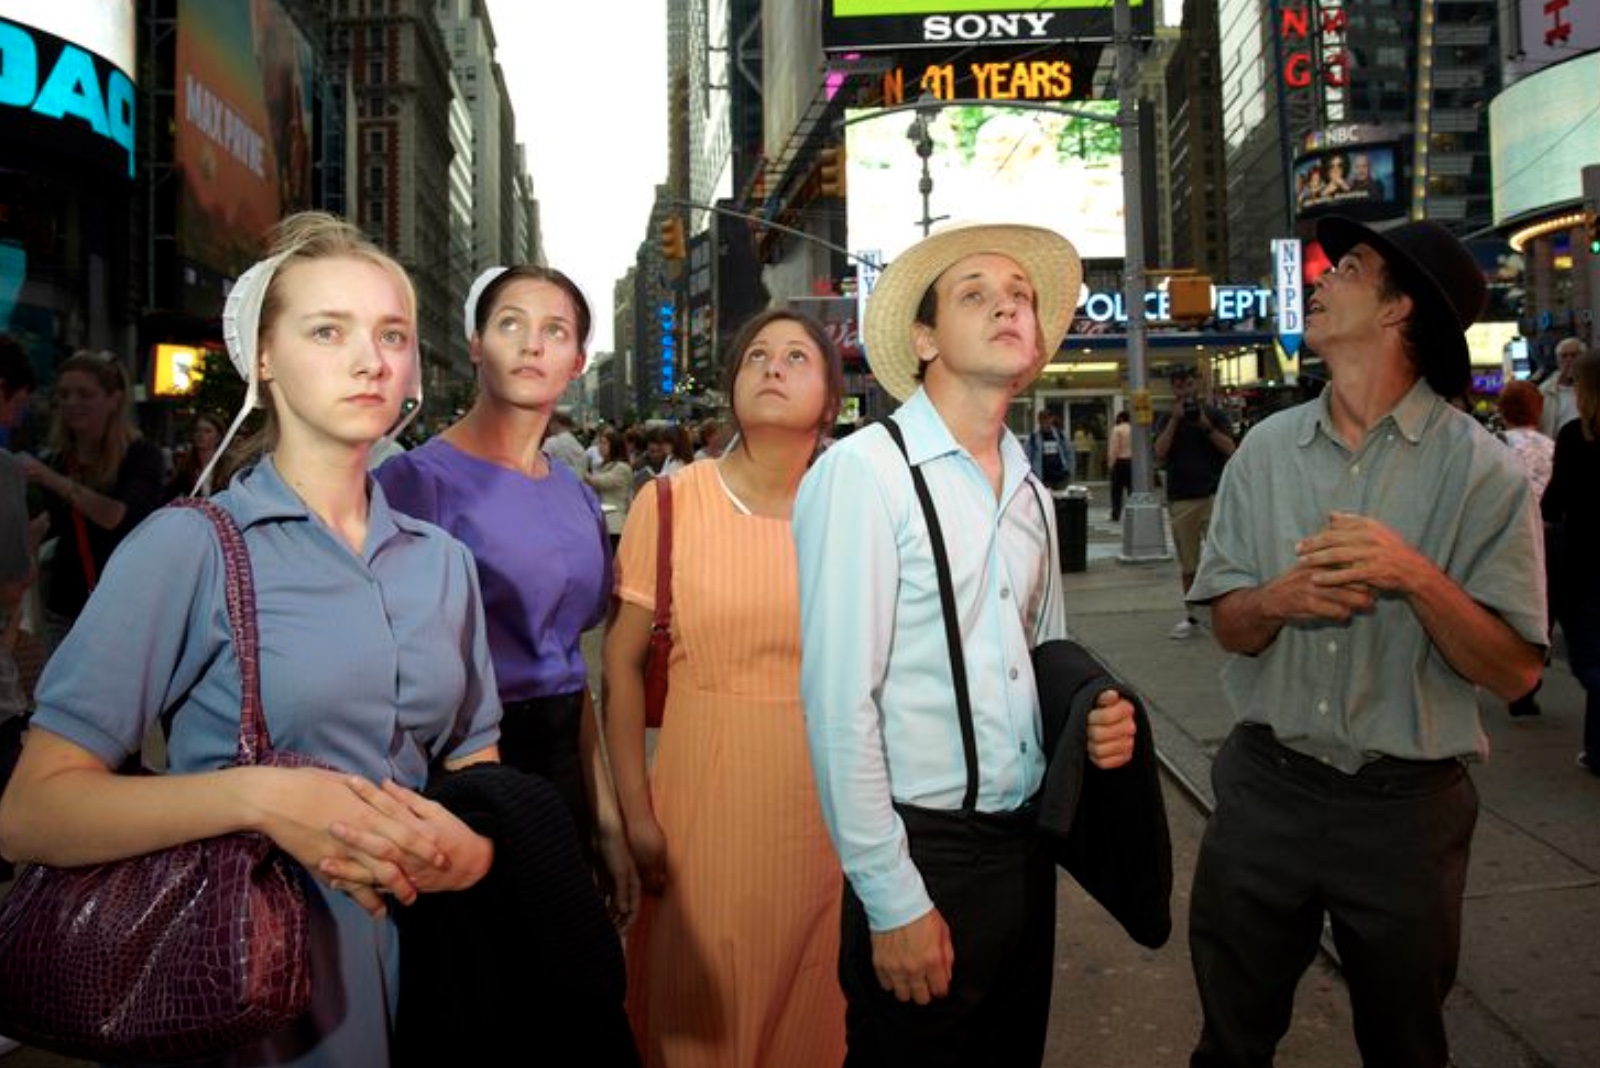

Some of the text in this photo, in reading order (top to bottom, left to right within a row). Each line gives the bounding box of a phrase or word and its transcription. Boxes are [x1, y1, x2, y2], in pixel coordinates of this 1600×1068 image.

[923, 12, 1054, 40] SONY
[0, 20, 136, 178] DAQ
[971, 61, 1071, 99] YEARS
[186, 73, 266, 178] MAX PAYNE
[1325, 125, 1359, 144] NBC
[1077, 283, 1271, 322] OLCE EPT
[1282, 243, 1297, 331] NYPD
